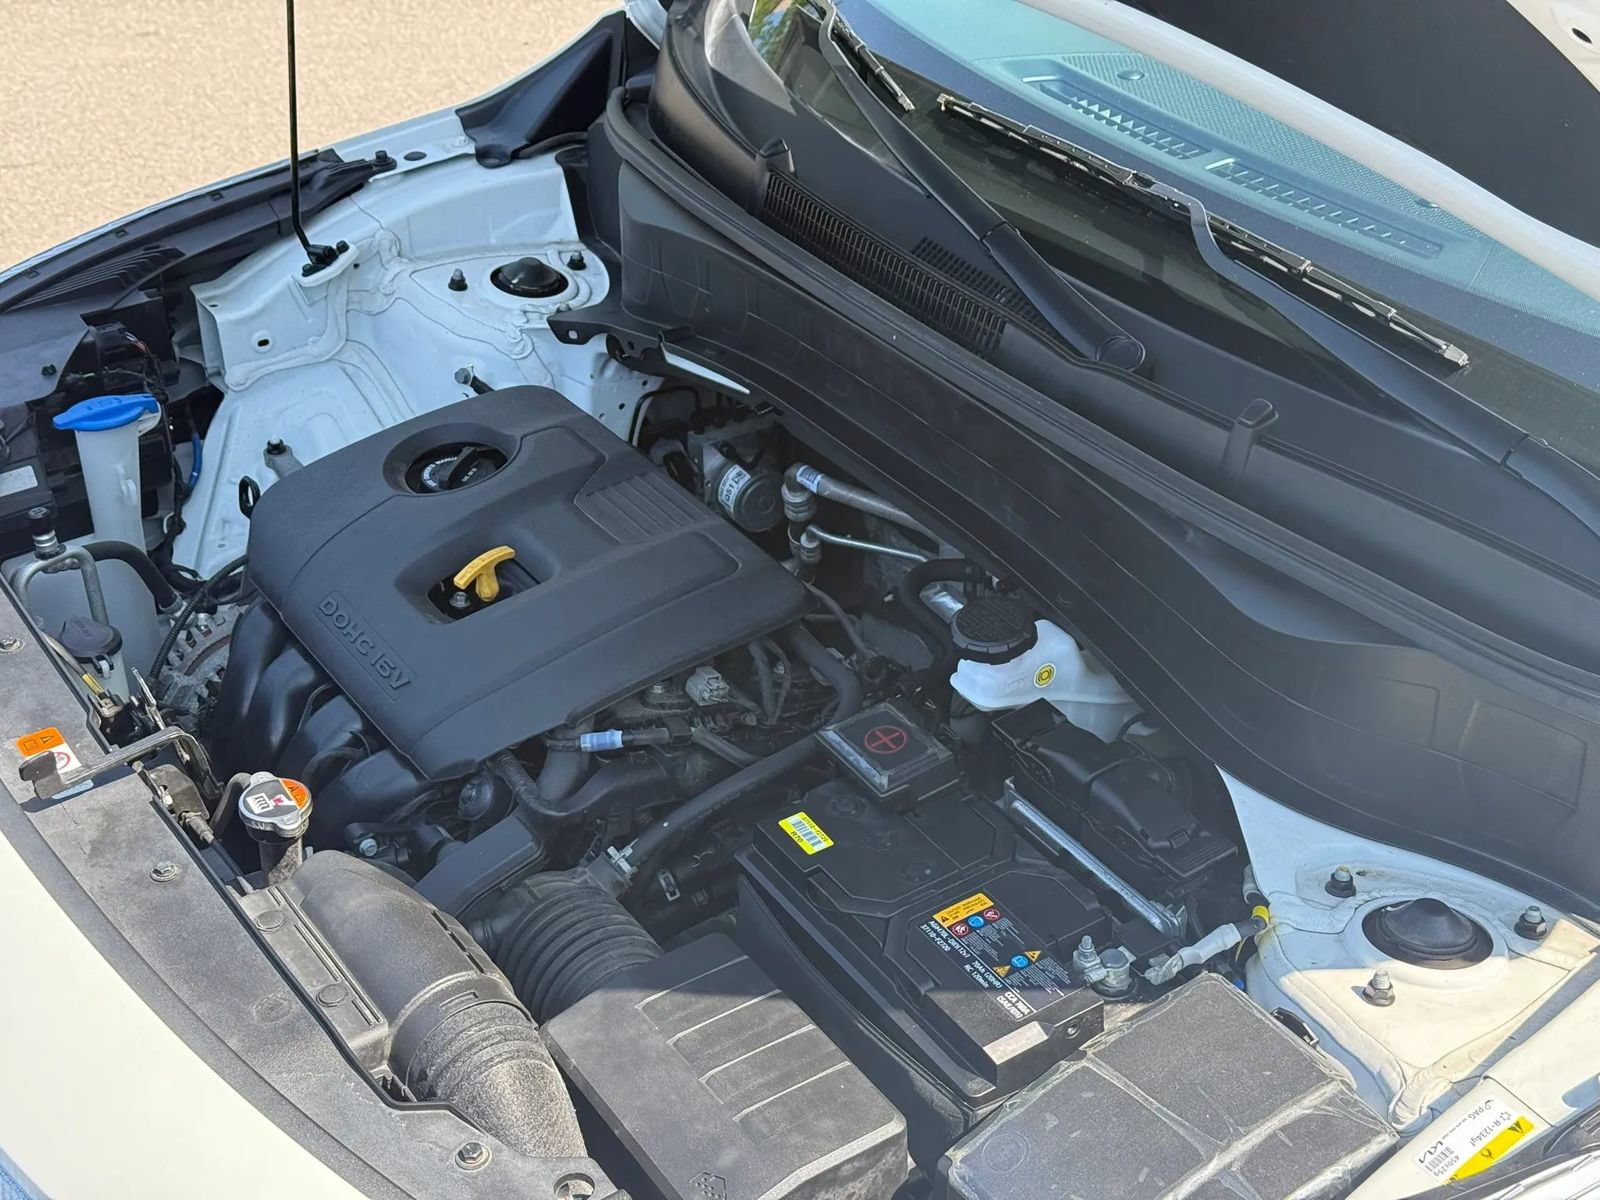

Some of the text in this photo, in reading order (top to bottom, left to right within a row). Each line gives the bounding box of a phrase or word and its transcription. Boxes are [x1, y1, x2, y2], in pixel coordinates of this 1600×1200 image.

[318, 595, 411, 691] DOHC 16V
[919, 923, 951, 952] 37110-F2720
[964, 964, 973, 974] RC
[971, 970, 989, 989] 120min
[984, 970, 1003, 989] (20HR)
[1004, 991, 1018, 1004] CCA
[1468, 1106, 1485, 1121] PAG
[1469, 1121, 1502, 1147] R-1234yf
[1418, 1140, 1444, 1164] KIA
